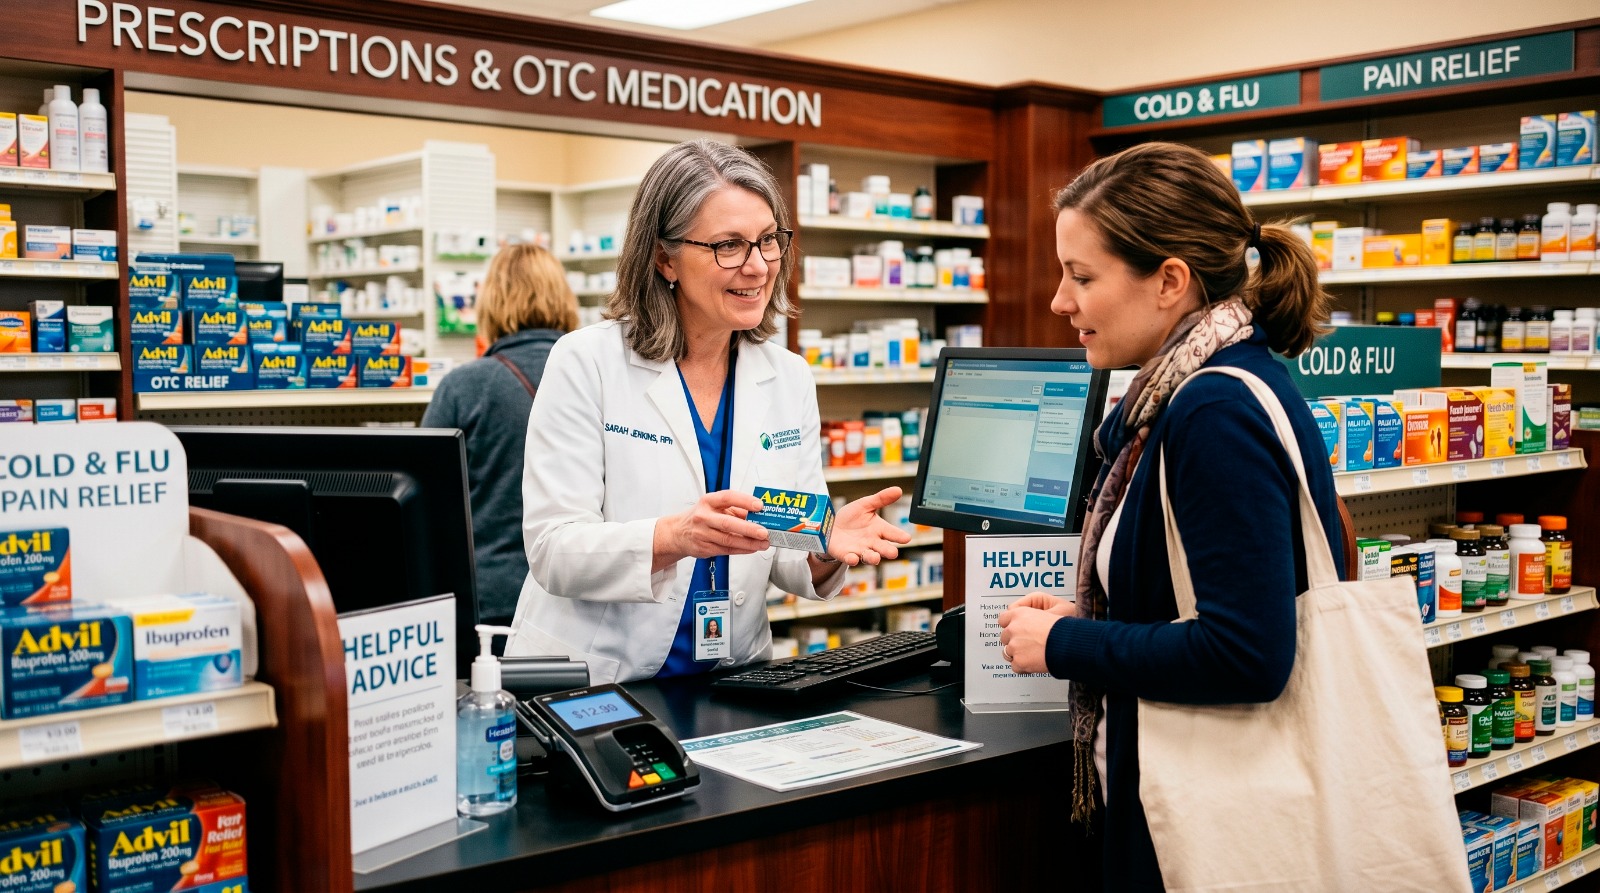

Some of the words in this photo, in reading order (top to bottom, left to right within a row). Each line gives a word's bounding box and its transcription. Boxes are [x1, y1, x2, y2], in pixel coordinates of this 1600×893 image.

[77, 0, 459, 86] PRESCRIPTIONS
[471, 48, 501, 91] &
[513, 54, 597, 101] OTC
[606, 66, 822, 127] MEDICATION
[1363, 60, 1422, 92] PAIN
[1431, 45, 1521, 83] RELIEF
[1133, 91, 1194, 121] COLD
[1197, 88, 1214, 112] &
[1218, 82, 1261, 109] FLU
[129, 275, 167, 288] Advil
[189, 277, 227, 290] Advil
[132, 311, 172, 324] Advil
[199, 312, 237, 325] Advil
[307, 320, 343, 333] Advil
[355, 324, 390, 337] Advil
[139, 346, 178, 359] Advil
[202, 347, 239, 359] Advil
[260, 355, 297, 368] Advil
[312, 355, 347, 368] Advil
[1299, 346, 1346, 376] COLD
[1349, 346, 1362, 375] &
[1366, 346, 1395, 375] FLU
[364, 356, 400, 369] Advil
[150, 375, 180, 389] OTC
[184, 375, 230, 389] RELIEF
[604, 423, 629, 436] SARAH
[85, 451, 107, 475] &
[116, 449, 170, 474] FLU
[2, 486, 69, 513] PAIN
[78, 482, 168, 509] RELIEF
[760, 490, 808, 509] Advil
[0, 531, 51, 555] dvil
[24, 552, 55, 565] 200mg
[982, 550, 1074, 568] HELPFUL
[989, 571, 1065, 589] ADVICE
[12, 620, 102, 656] Advil
[146, 625, 230, 646] Ibuprofen
[342, 620, 444, 662] HELPFUL
[11, 653, 67, 674] Ibuprofen
[68, 648, 105, 664] 200mg
[351, 652, 437, 695] ADVICE
[109, 818, 191, 858] Advil
[0, 838, 63, 875] dvil
[108, 851, 159, 871] Ibuprofen
[160, 845, 192, 859] 200mg
[30, 867, 65, 882] 200mg
